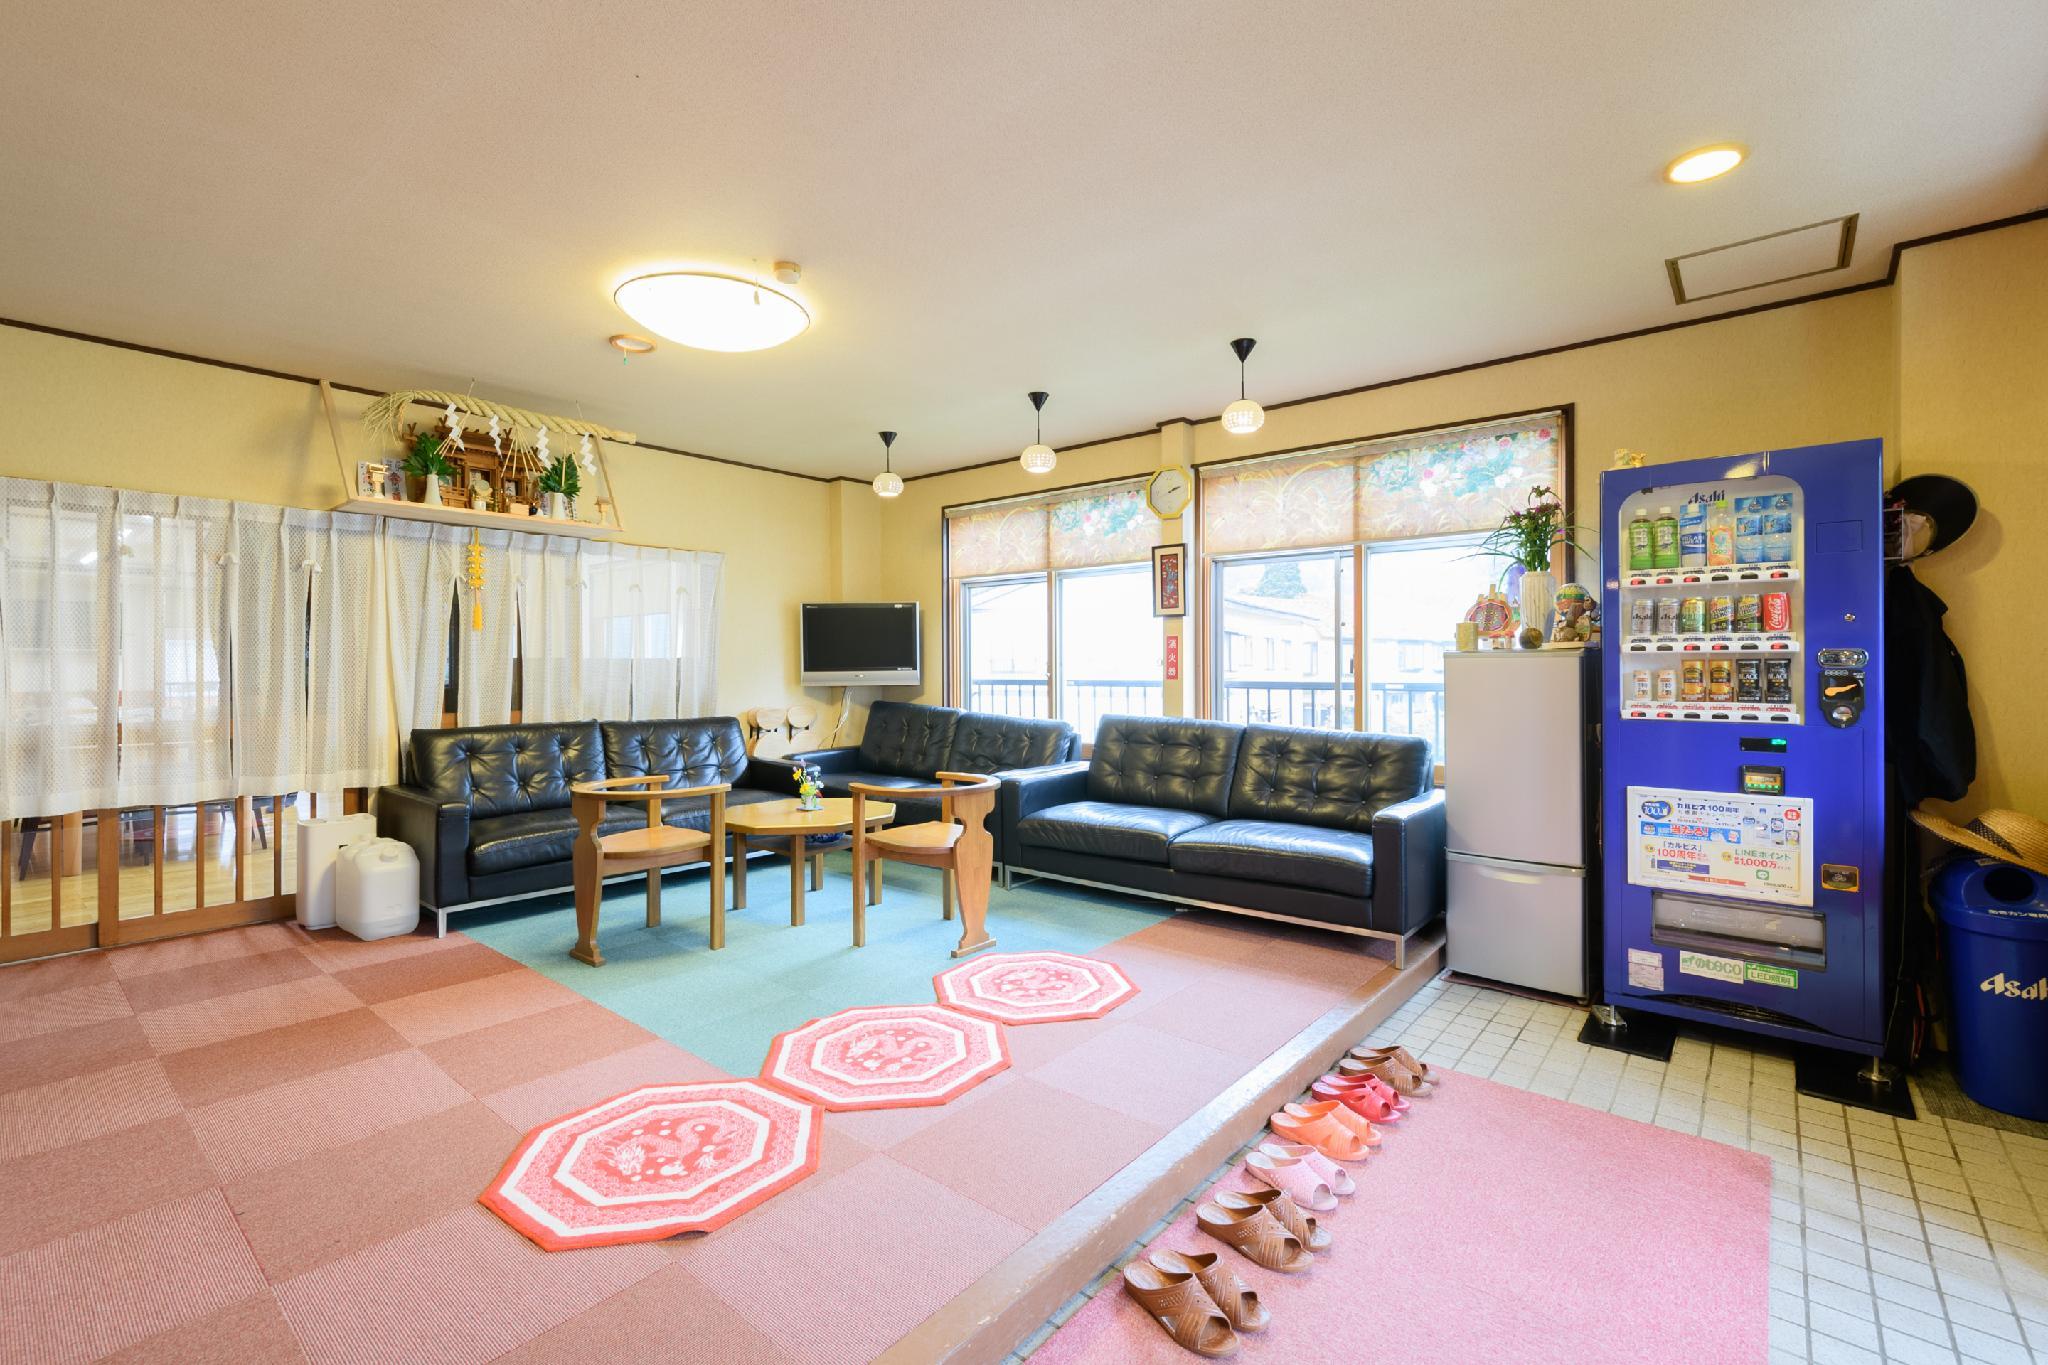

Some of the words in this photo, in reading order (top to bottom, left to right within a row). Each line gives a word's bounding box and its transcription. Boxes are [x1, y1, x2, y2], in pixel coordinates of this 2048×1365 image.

[1688, 489, 1725, 504] Asahi
[1168, 640, 1177, 677] 消火器
